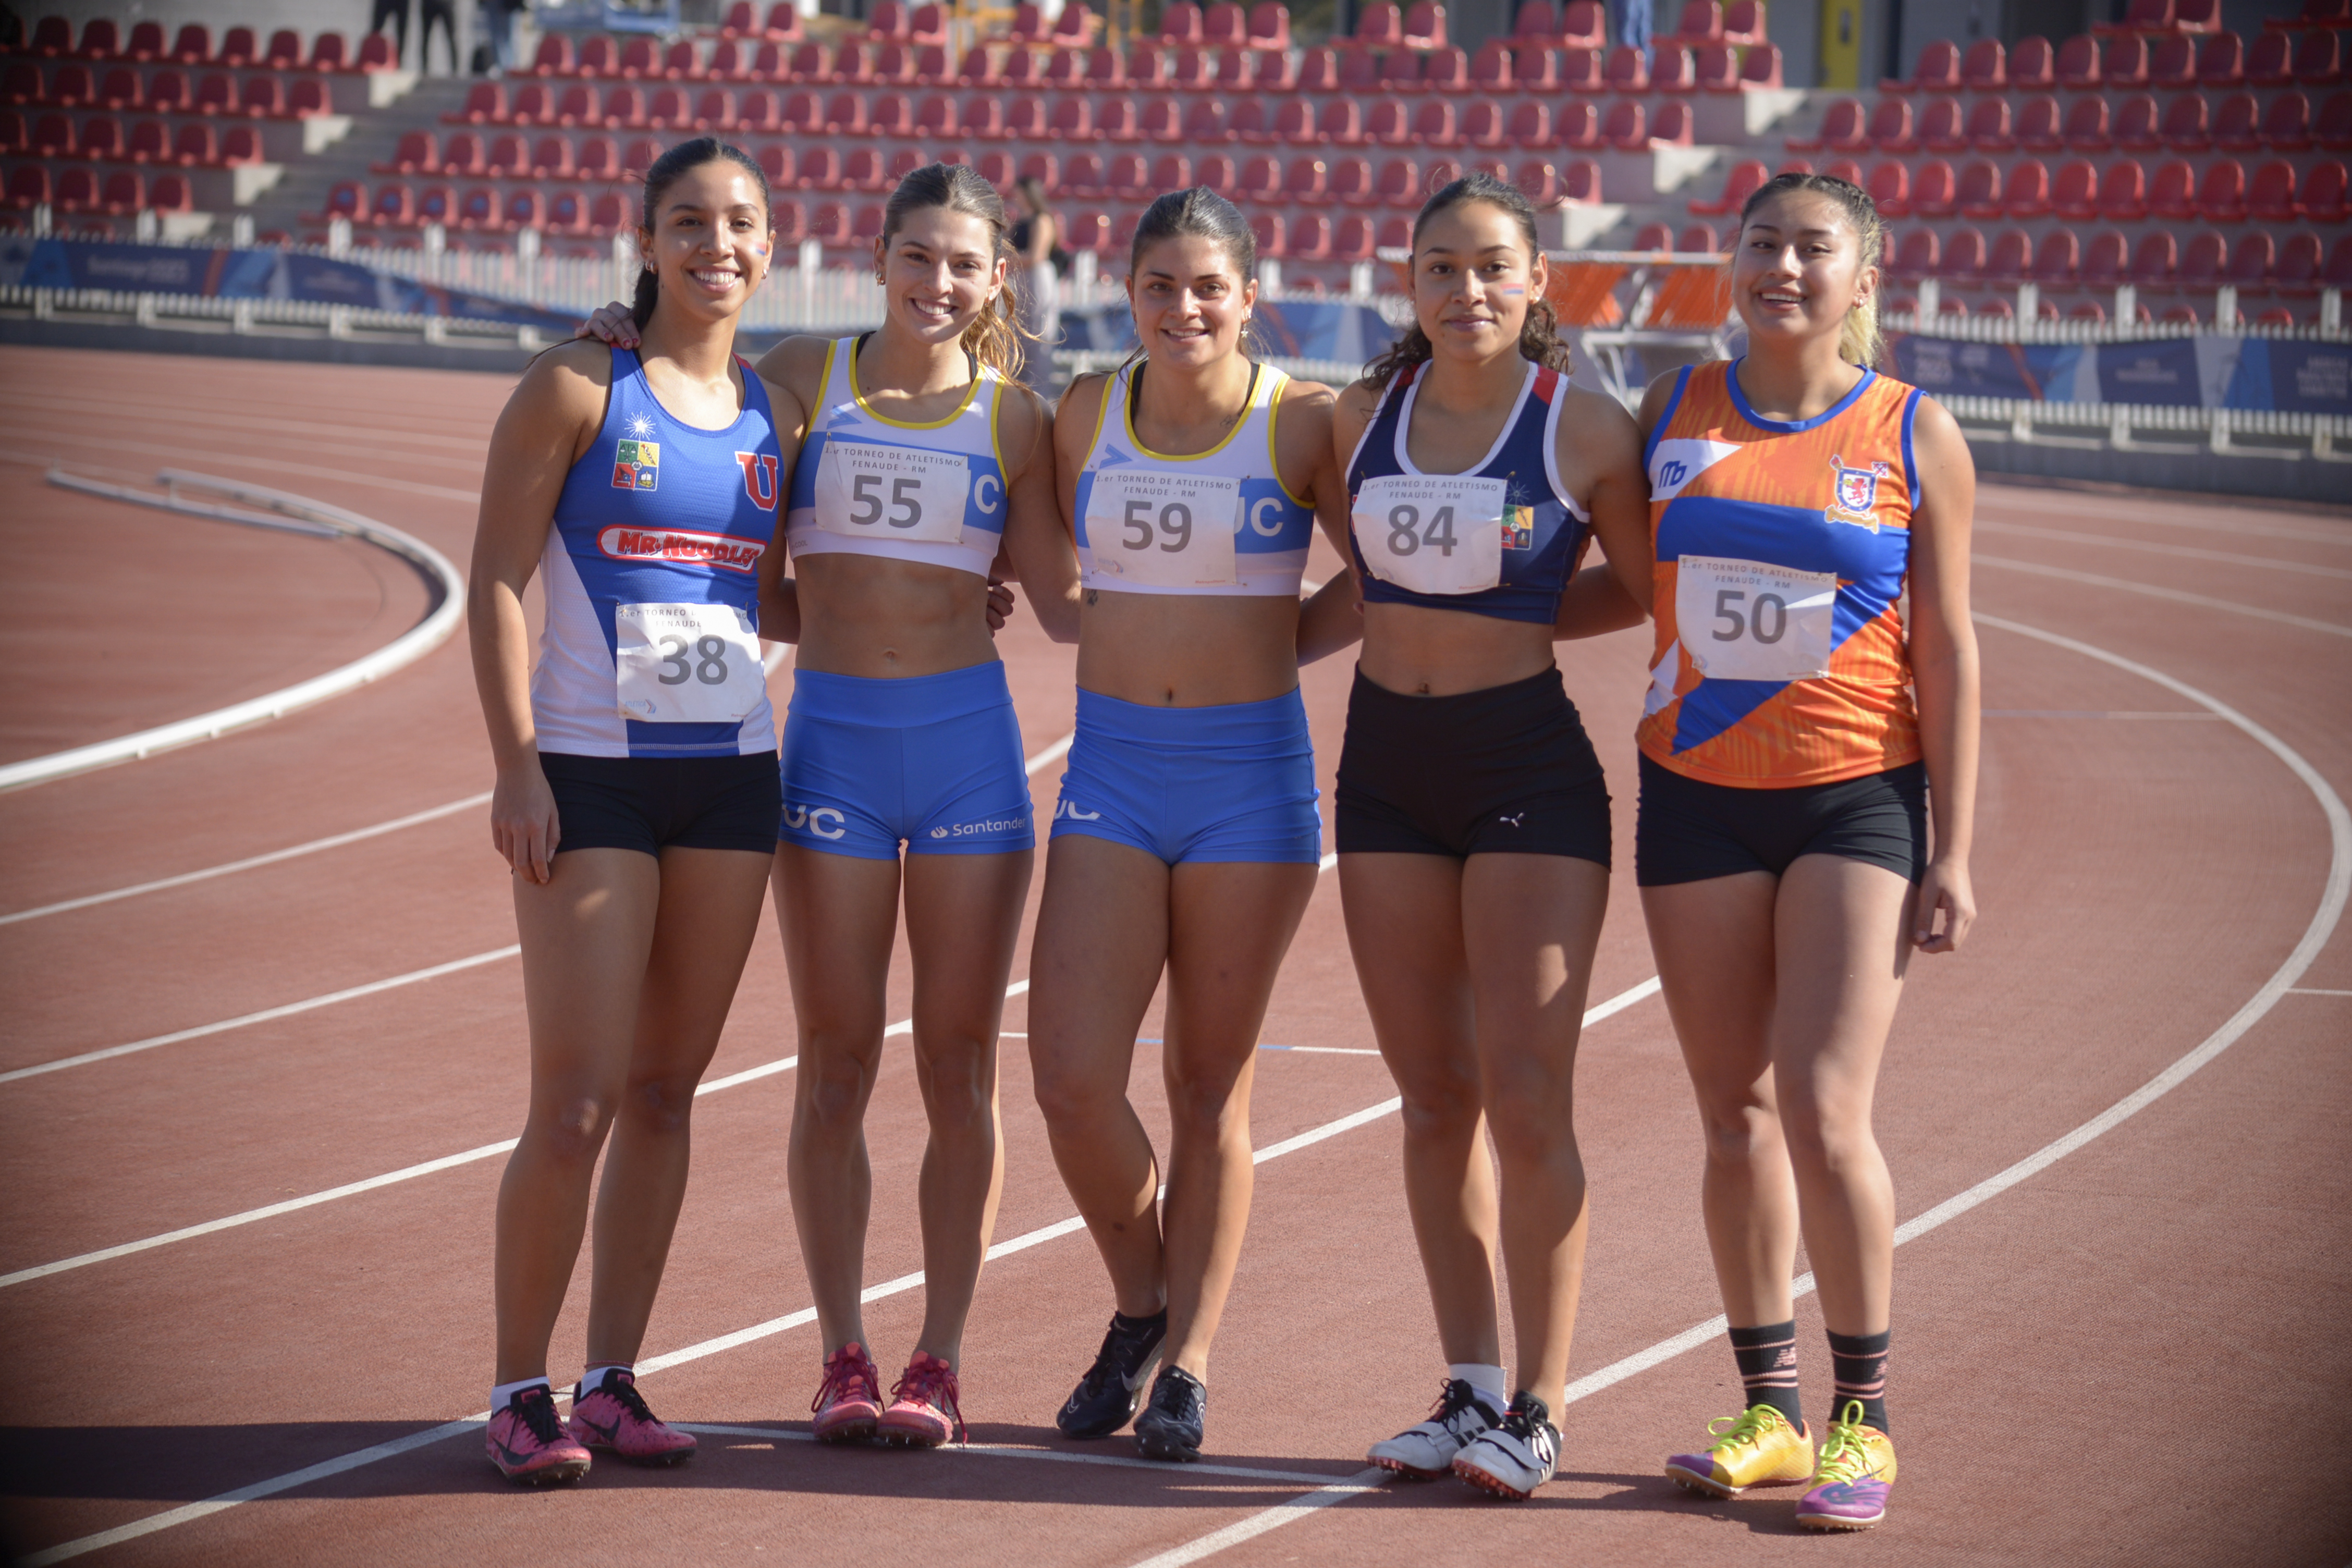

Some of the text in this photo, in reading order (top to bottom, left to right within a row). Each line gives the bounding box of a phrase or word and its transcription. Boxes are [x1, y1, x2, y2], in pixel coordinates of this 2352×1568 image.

[844, 448, 884, 459] TORNEO
[905, 454, 961, 467] ATLETISMO
[852, 460, 899, 471] FENAUDE
[734, 451, 778, 511] U
[1117, 475, 1155, 484] TORNEO
[1176, 479, 1232, 489] ATLETISMO
[1124, 486, 1169, 496] FENAUDE
[1440, 481, 1498, 492] ATLETISMO
[850, 474, 922, 528] 55
[1122, 500, 1192, 553] 59
[1387, 505, 1457, 557] 84
[1706, 562, 1746, 572] TORNEO
[1751, 567, 1763, 575] DE
[1769, 569, 1828, 582] ATLETISMO
[1715, 575, 1761, 585] FENAUDE
[1712, 589, 1786, 644] 50
[658, 634, 728, 685] 38
[782, 804, 846, 840] UC
[953, 817, 1025, 836] Santander
